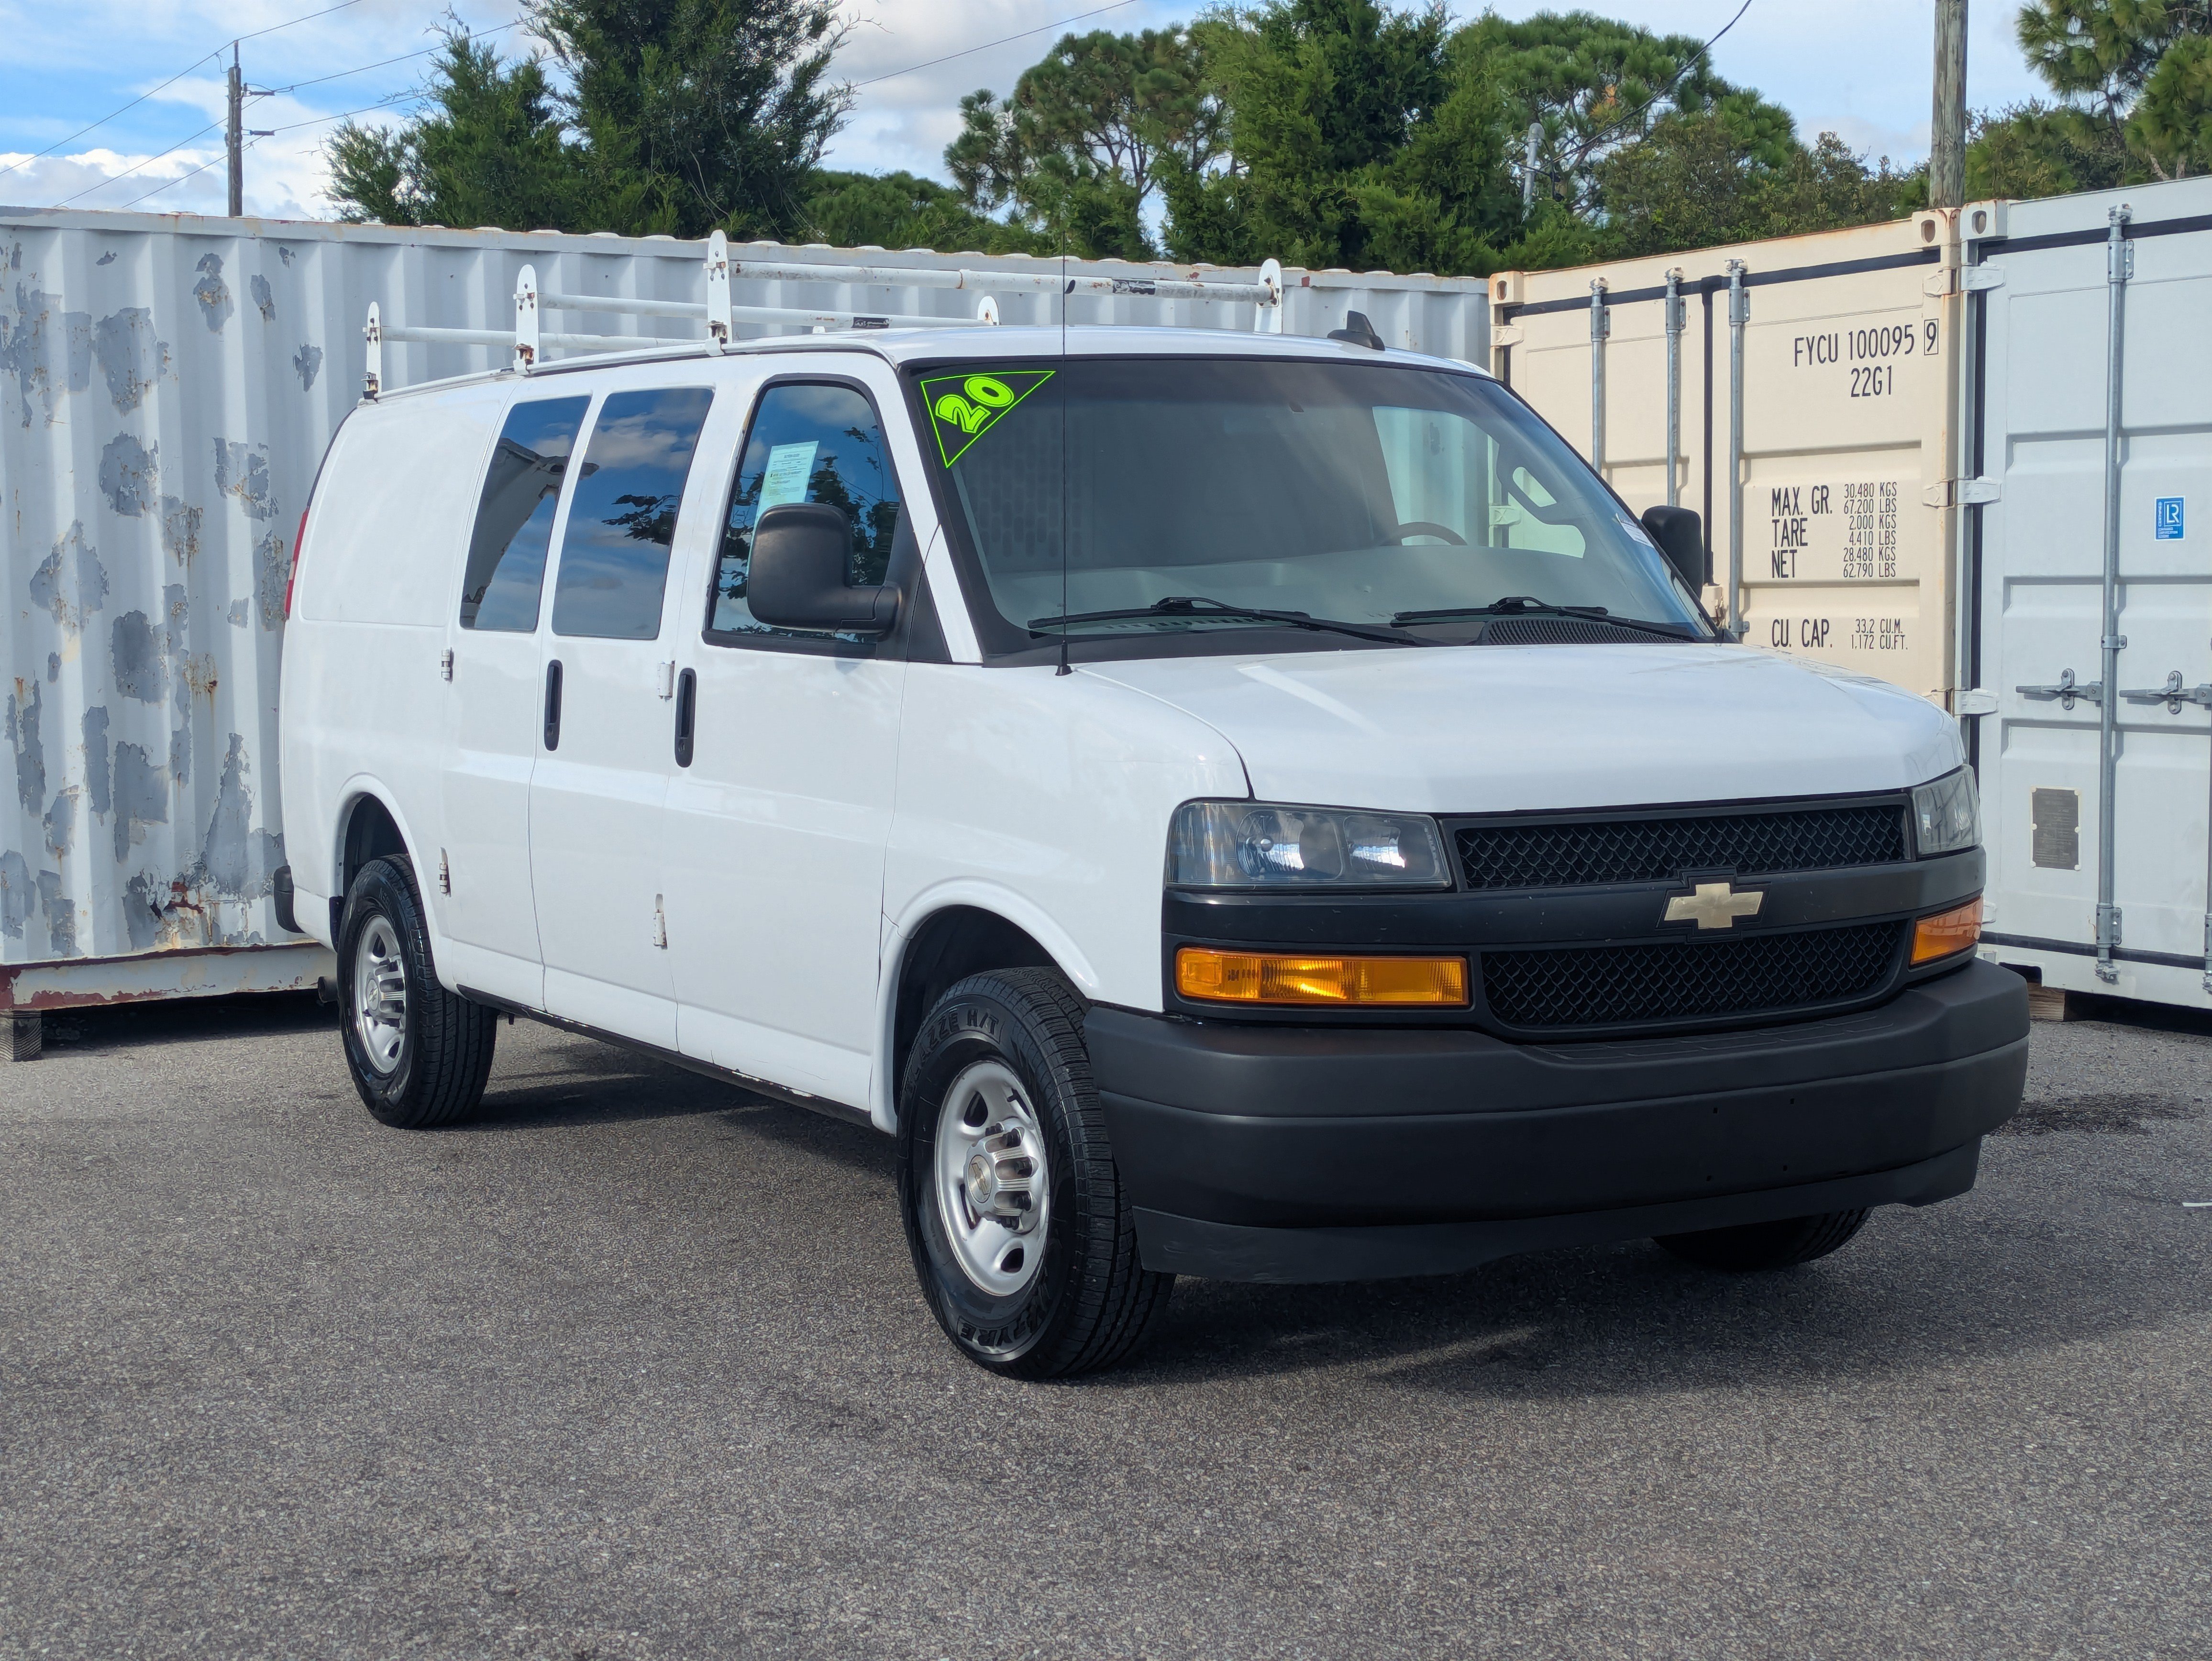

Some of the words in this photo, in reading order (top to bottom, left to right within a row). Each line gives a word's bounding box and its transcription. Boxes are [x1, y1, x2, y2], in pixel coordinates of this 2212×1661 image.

[1794, 333, 1838, 367] FYCU
[1848, 324, 1914, 361] 100095
[1926, 322, 1937, 353] 9
[1850, 365, 1892, 398] 22G1
[936, 376, 1014, 433] 20
[1771, 486, 1803, 517] MAX.
[1811, 485, 1833, 514] GR.
[1879, 481, 1897, 497] KGS
[1879, 498, 1897, 513] LBS
[2167, 504, 2179, 523] LR
[1771, 517, 1808, 547] TARE
[1879, 514, 1896, 530] KGS
[1879, 530, 1896, 545] LBS
[1771, 549, 1798, 578] NET
[1879, 546, 1896, 562] KGS
[1878, 562, 1896, 577] LBS
[1771, 619, 1792, 648] CU.
[1802, 619, 1833, 648] CAP.
[1855, 618, 1875, 634] 33.2
[960, 1309, 1029, 1347] TYRE
